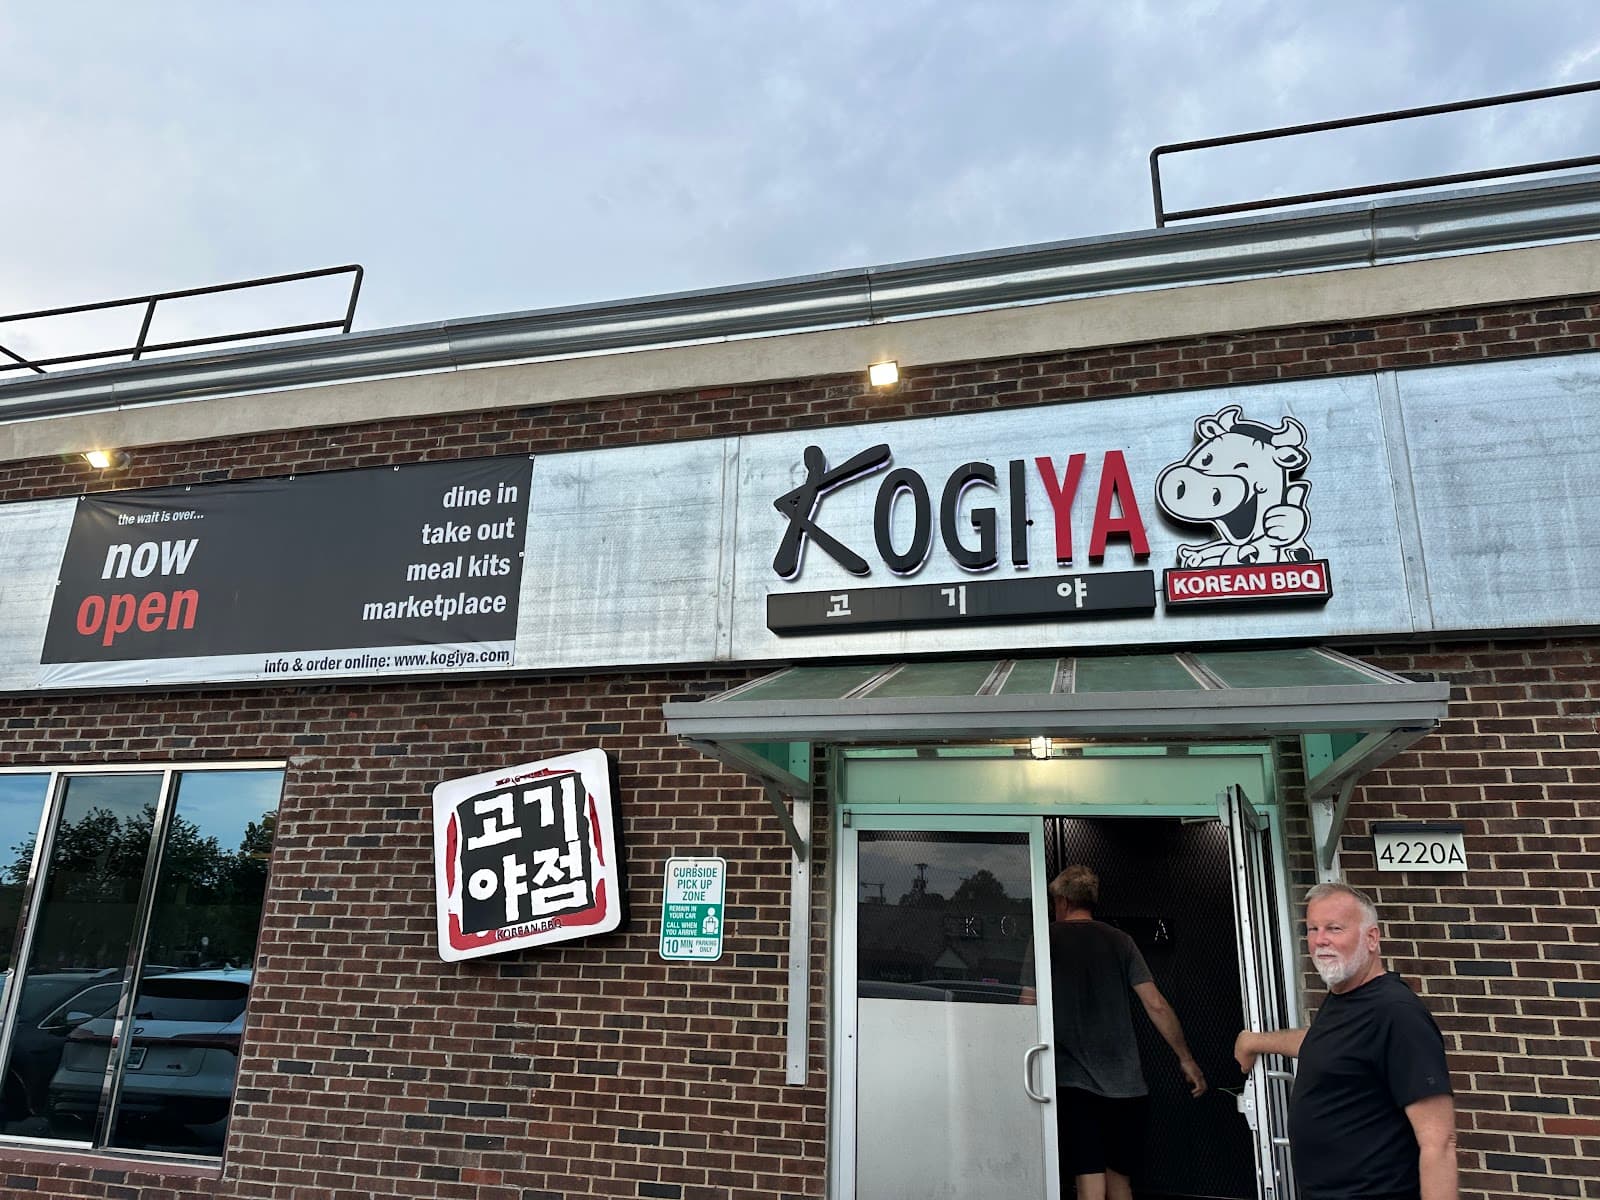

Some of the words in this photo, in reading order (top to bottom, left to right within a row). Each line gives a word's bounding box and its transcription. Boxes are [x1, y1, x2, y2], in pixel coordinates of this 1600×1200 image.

[443, 485, 491, 508] dine
[497, 482, 518, 503] in
[118, 514, 135, 525] the
[137, 512, 160, 524] wait
[161, 511, 171, 522] is
[172, 510, 204, 521] over...
[773, 443, 1151, 579] KOGIYA
[421, 521, 472, 545] take
[477, 517, 516, 541] out
[101, 538, 199, 580] now
[406, 556, 463, 581] meal
[468, 554, 511, 577] kits
[1173, 572, 1267, 595] KOREAN
[1271, 569, 1320, 590] BBQ
[76, 588, 199, 647] open
[362, 592, 507, 621] marketplace
[264, 659, 289, 673] info
[292, 658, 303, 672] &
[306, 656, 342, 671] order
[344, 654, 391, 669] online:
[394, 649, 510, 667] www.kogiya.com
[1380, 842, 1464, 864] 4220A
[673, 867, 718, 878] CURBSIDE
[677, 879, 697, 889] PICK
[700, 879, 713, 889] UP
[682, 891, 706, 901] ZONE
[665, 939, 679, 953] 10
[680, 940, 693, 948] MIN
